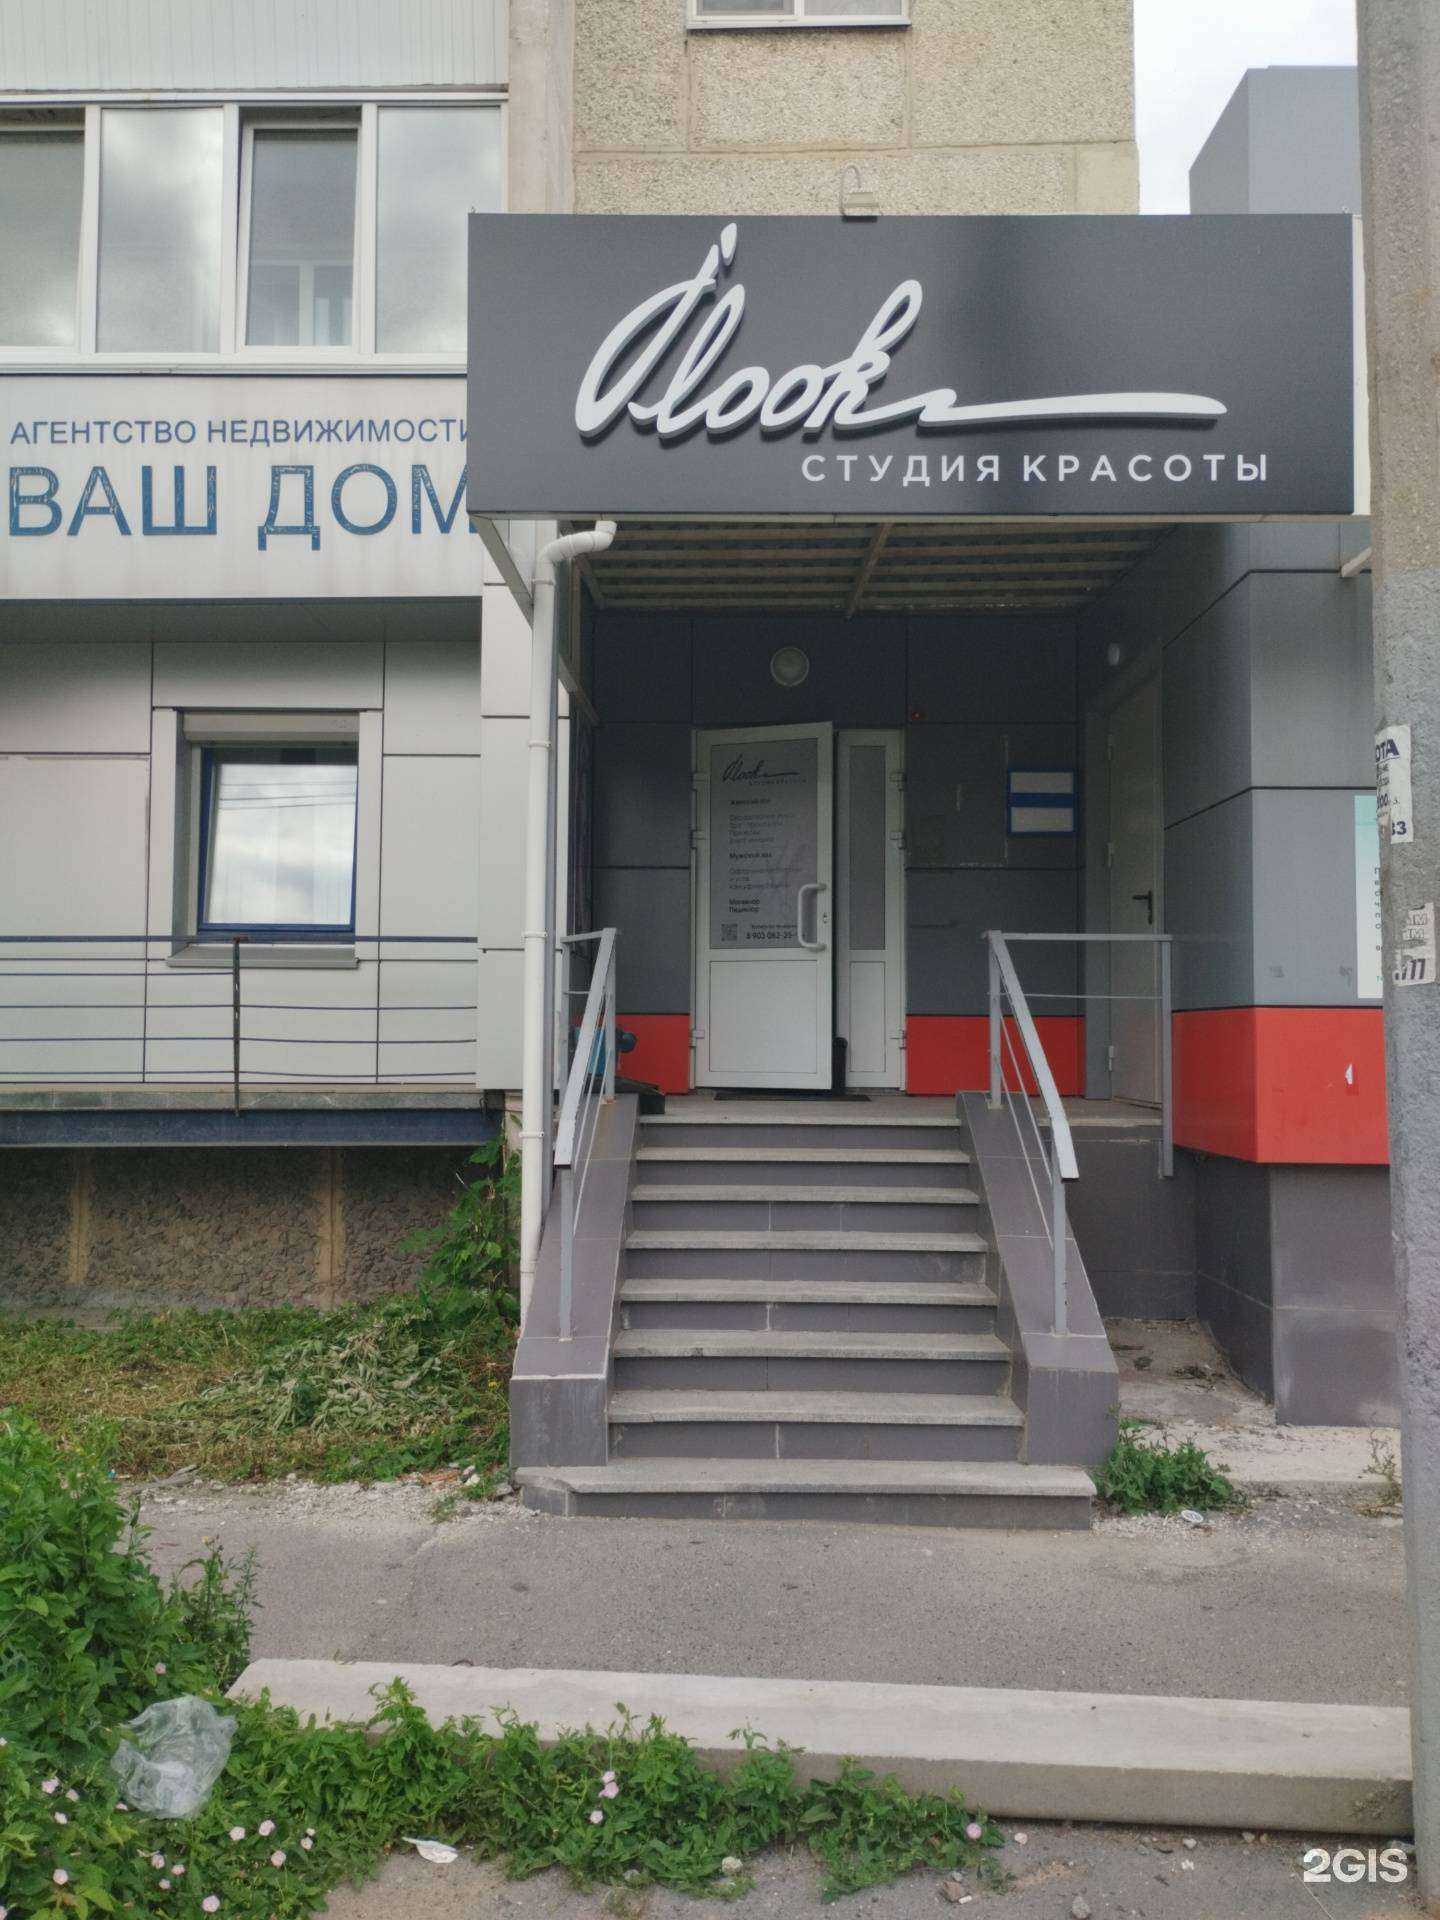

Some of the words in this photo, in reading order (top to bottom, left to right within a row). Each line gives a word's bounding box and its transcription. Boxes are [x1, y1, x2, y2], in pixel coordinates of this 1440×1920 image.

[10, 420, 197, 444] АГЕНТСТВО
[801, 454, 1000, 487] СТУДИЯ
[1023, 453, 1268, 482] КРАСОТЫ
[9, 465, 218, 536] ВАШ
[257, 463, 478, 551] ДОМ
